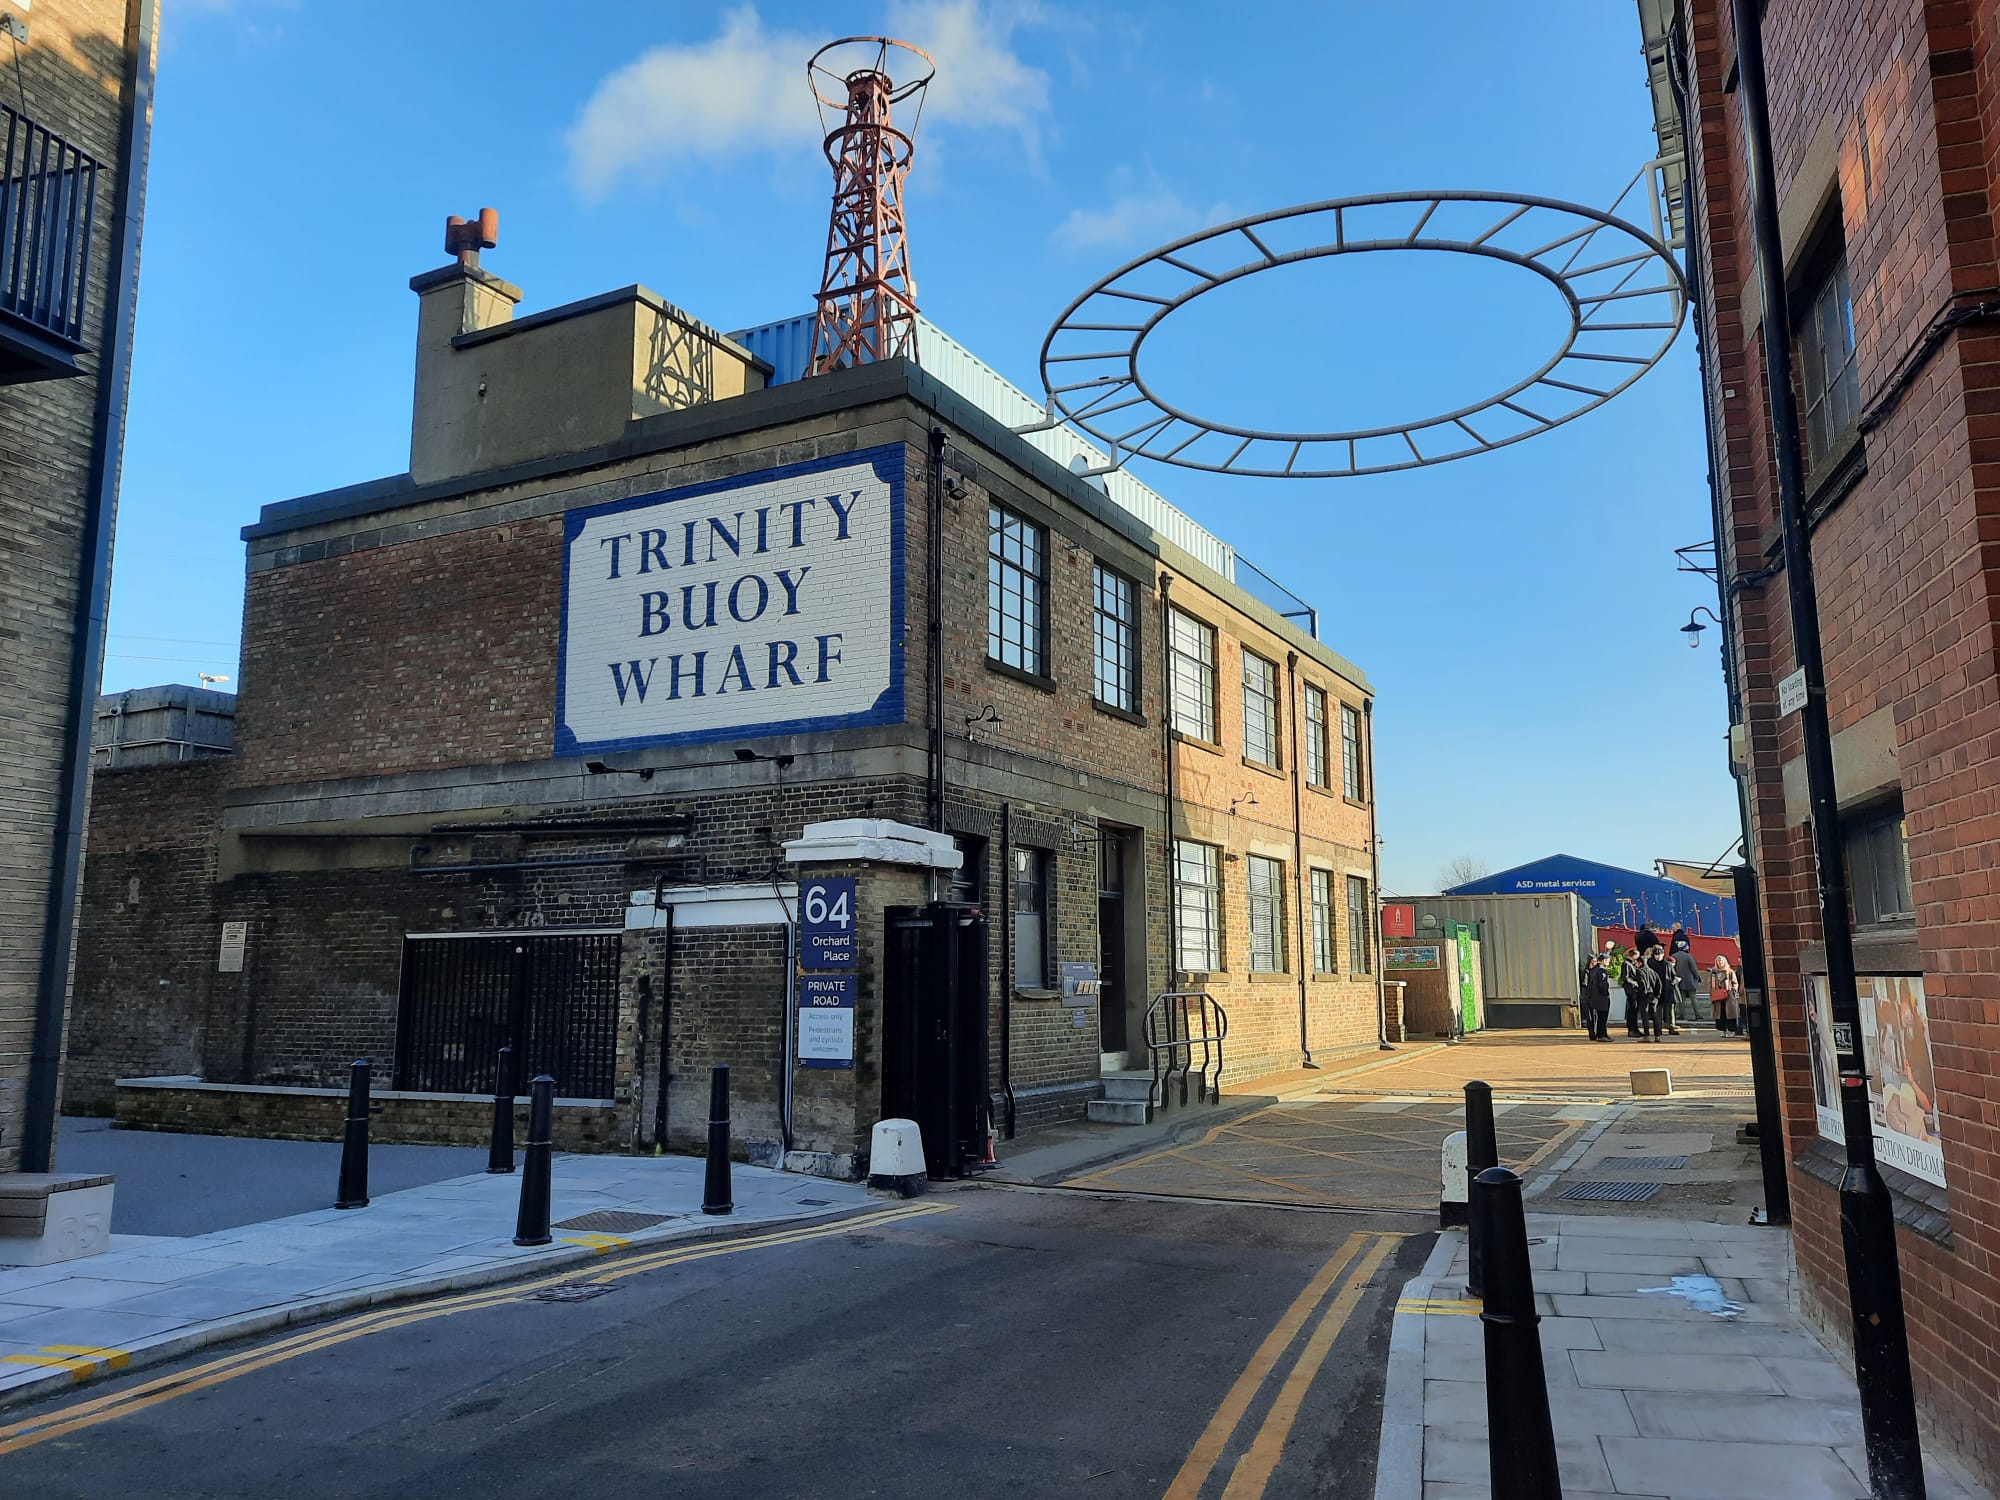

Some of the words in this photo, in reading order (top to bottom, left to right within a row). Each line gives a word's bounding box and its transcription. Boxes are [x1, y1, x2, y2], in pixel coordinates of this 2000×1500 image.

[600, 490, 863, 580] TRINITY
[638, 566, 812, 637] BUOY
[608, 633, 844, 706] WHARF
[1516, 880, 1533, 888] ASD
[1535, 880, 1560, 888] metal
[1562, 879, 1596, 887] services
[805, 885, 851, 929] 64
[812, 935, 850, 946] Orchard
[823, 951, 850, 961] Place
[808, 981, 846, 991] PRIVATE
[813, 995, 840, 1006] ROAD
[808, 1012, 829, 1020] Access
[831, 1012, 843, 1021] only
[1873, 1138, 1906, 1162] NDATION
